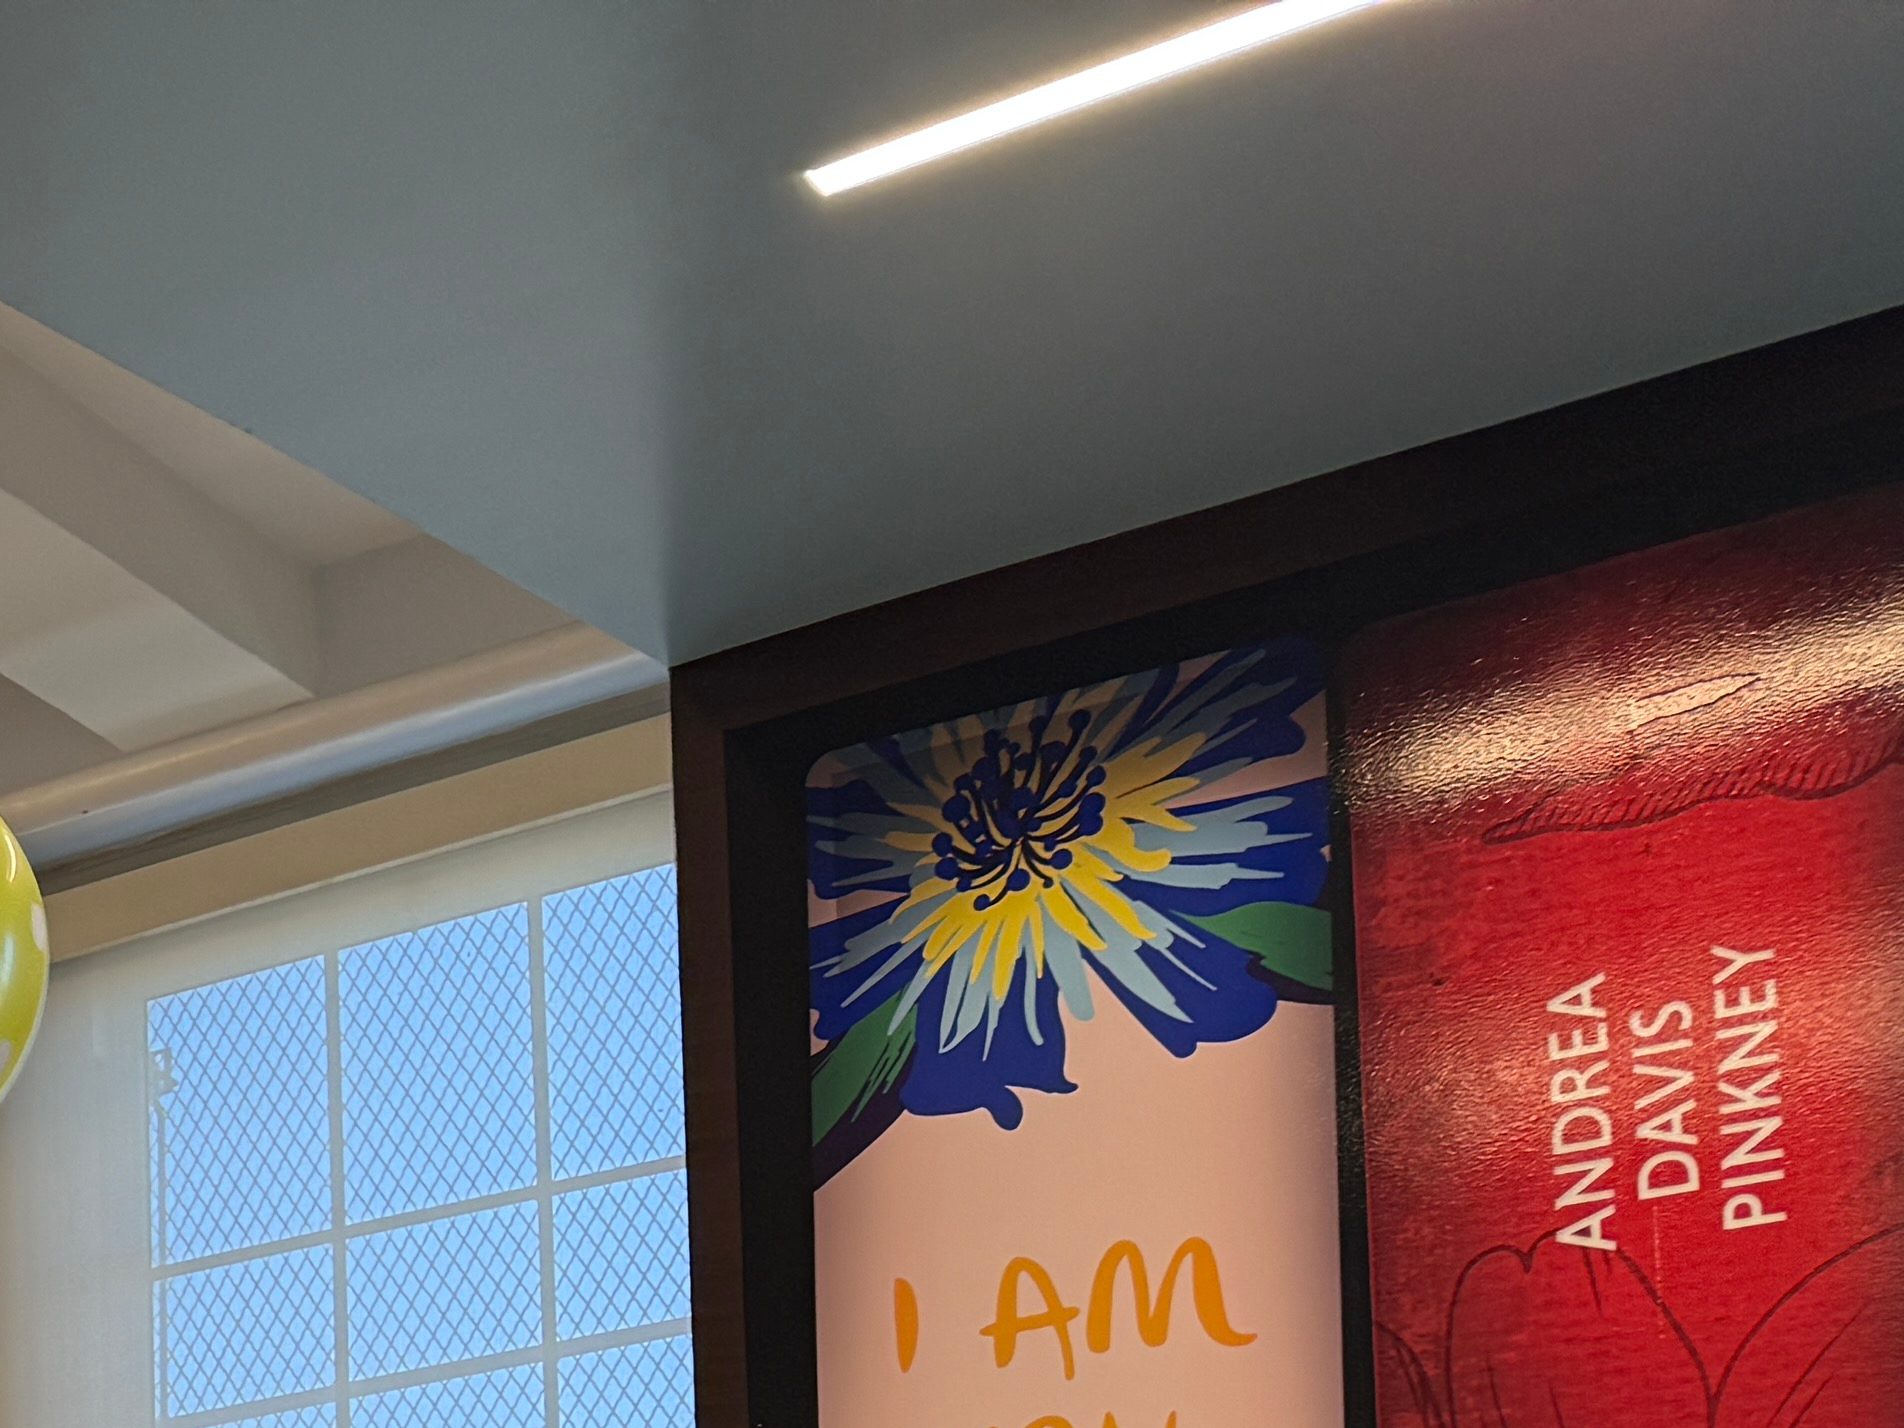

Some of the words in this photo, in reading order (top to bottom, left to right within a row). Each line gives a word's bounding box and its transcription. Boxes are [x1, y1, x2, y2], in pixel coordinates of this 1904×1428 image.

[1545, 971, 1617, 1251] ANDREA
[1629, 999, 1701, 1201] DAVIS
[1710, 944, 1788, 1231] PINKNEY
[894, 1277, 920, 1374] I
[979, 1236, 1258, 1381] AM
